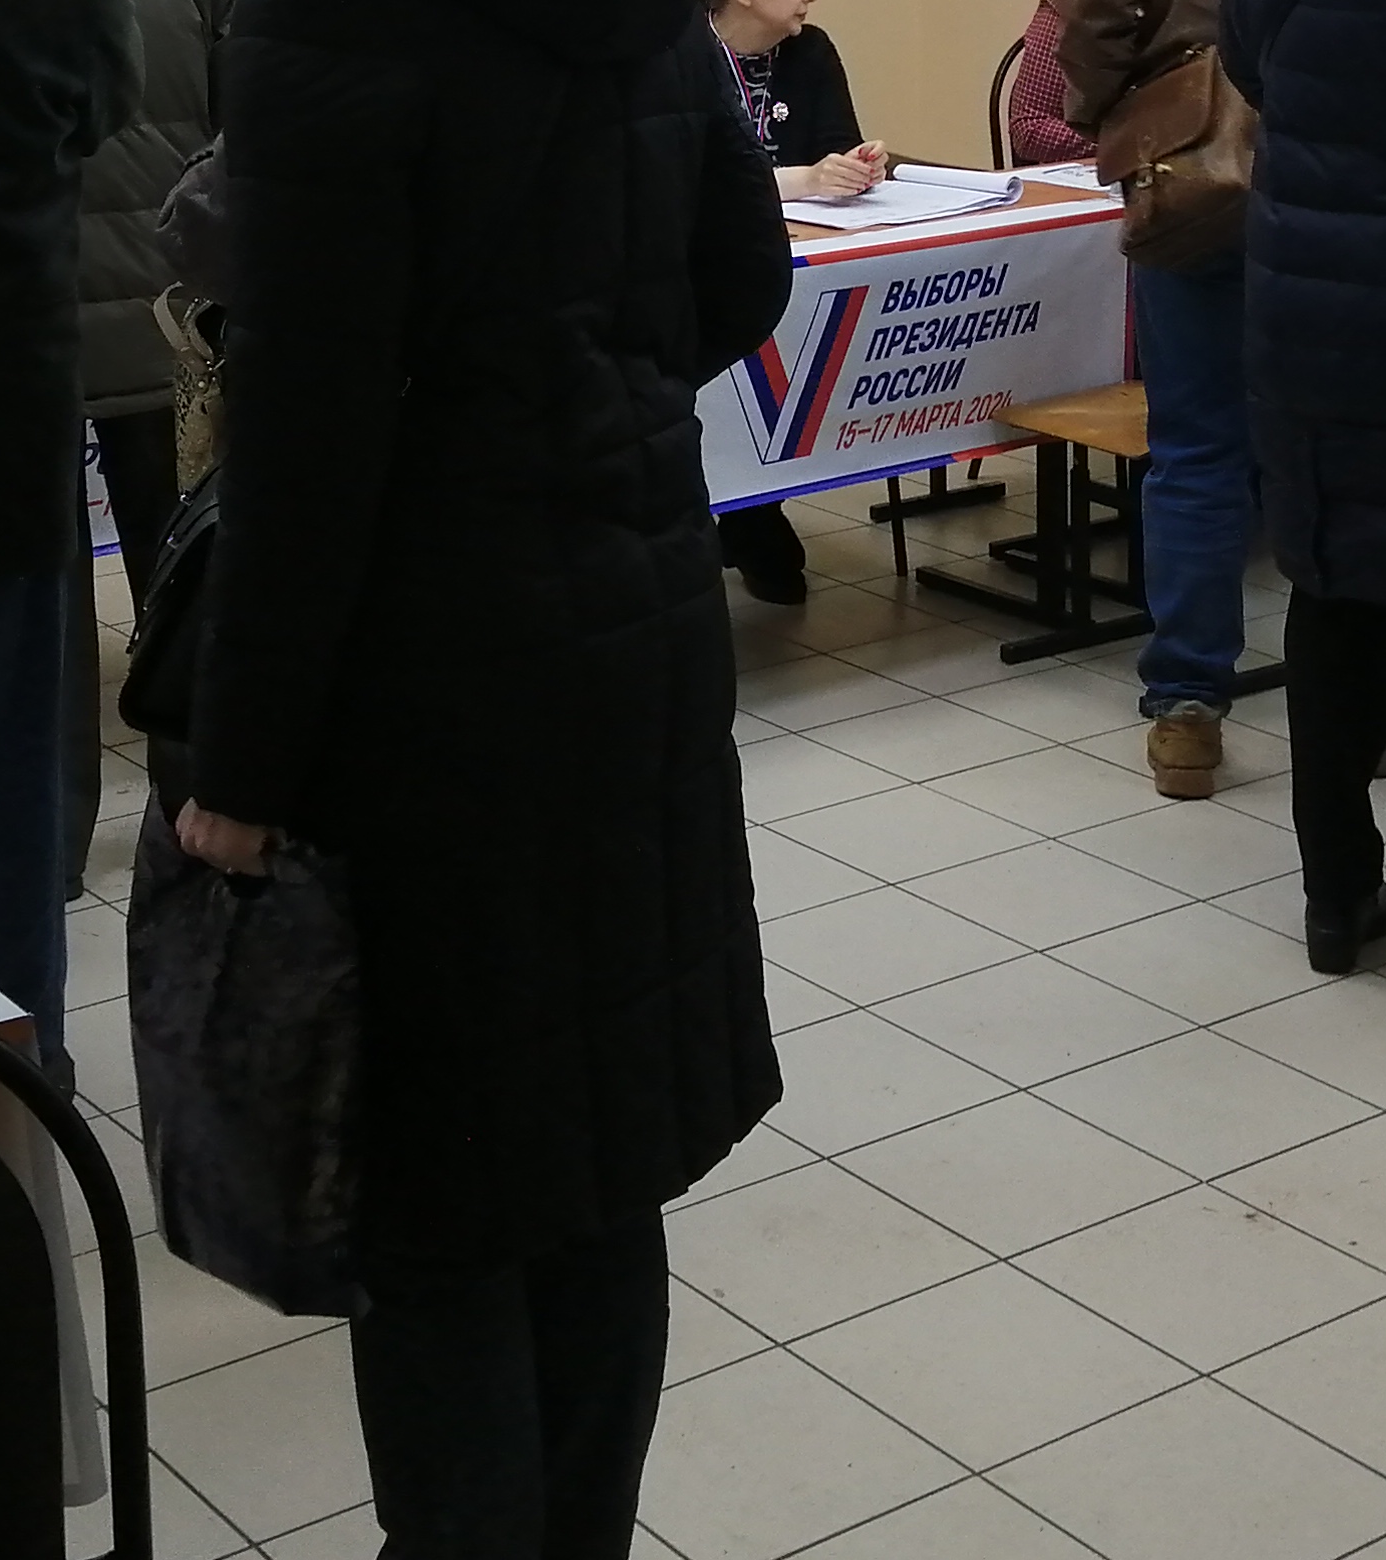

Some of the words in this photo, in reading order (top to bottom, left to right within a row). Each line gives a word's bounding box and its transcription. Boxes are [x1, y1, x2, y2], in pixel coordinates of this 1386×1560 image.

[880, 263, 1010, 316] ВЫБОРЫ
[864, 300, 1042, 363] ПРЕЗИДЕНТА
[846, 357, 967, 410] РОССИИ
[894, 399, 963, 441] МАРТА
